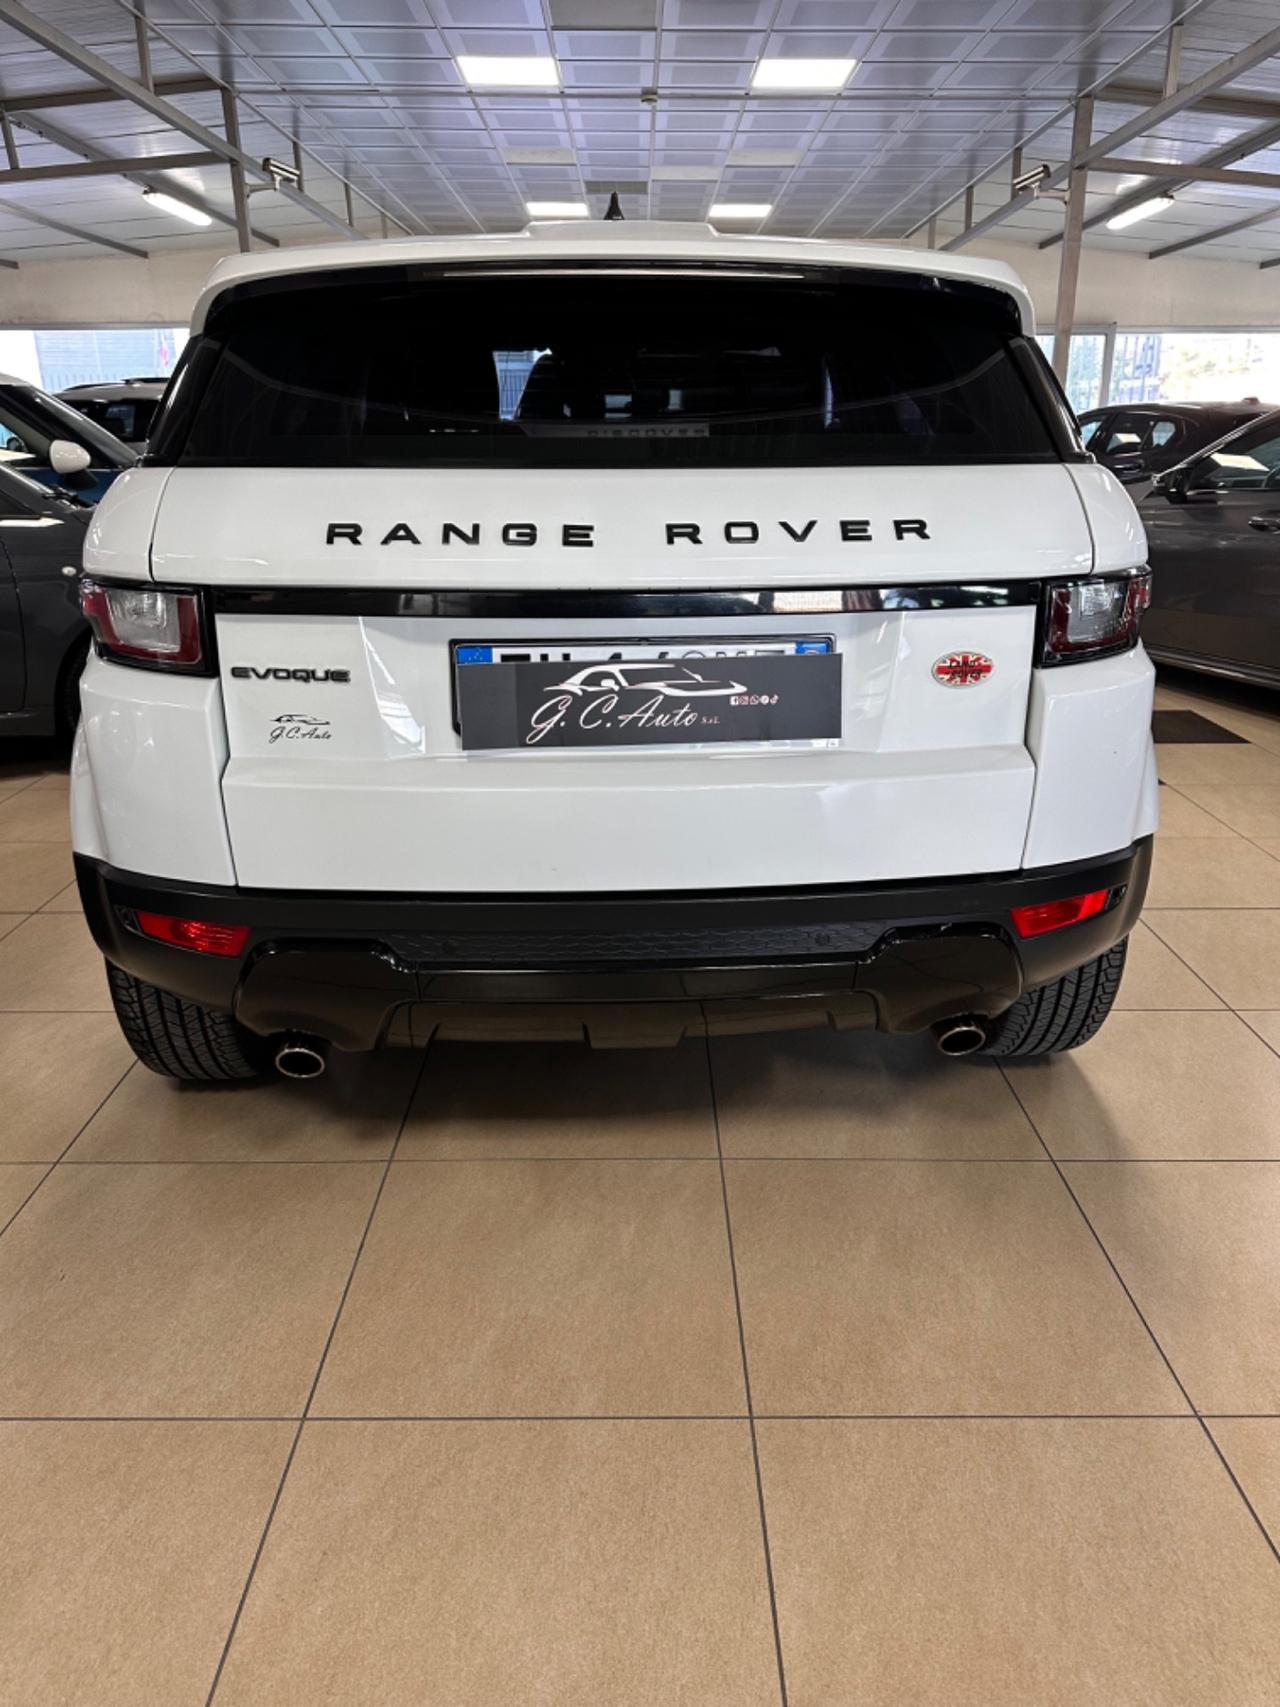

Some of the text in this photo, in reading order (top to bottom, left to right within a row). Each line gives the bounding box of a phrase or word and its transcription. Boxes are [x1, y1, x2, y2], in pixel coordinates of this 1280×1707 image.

[326, 519, 931, 548] RANGE ROVER
[231, 666, 351, 683] EVOQUE
